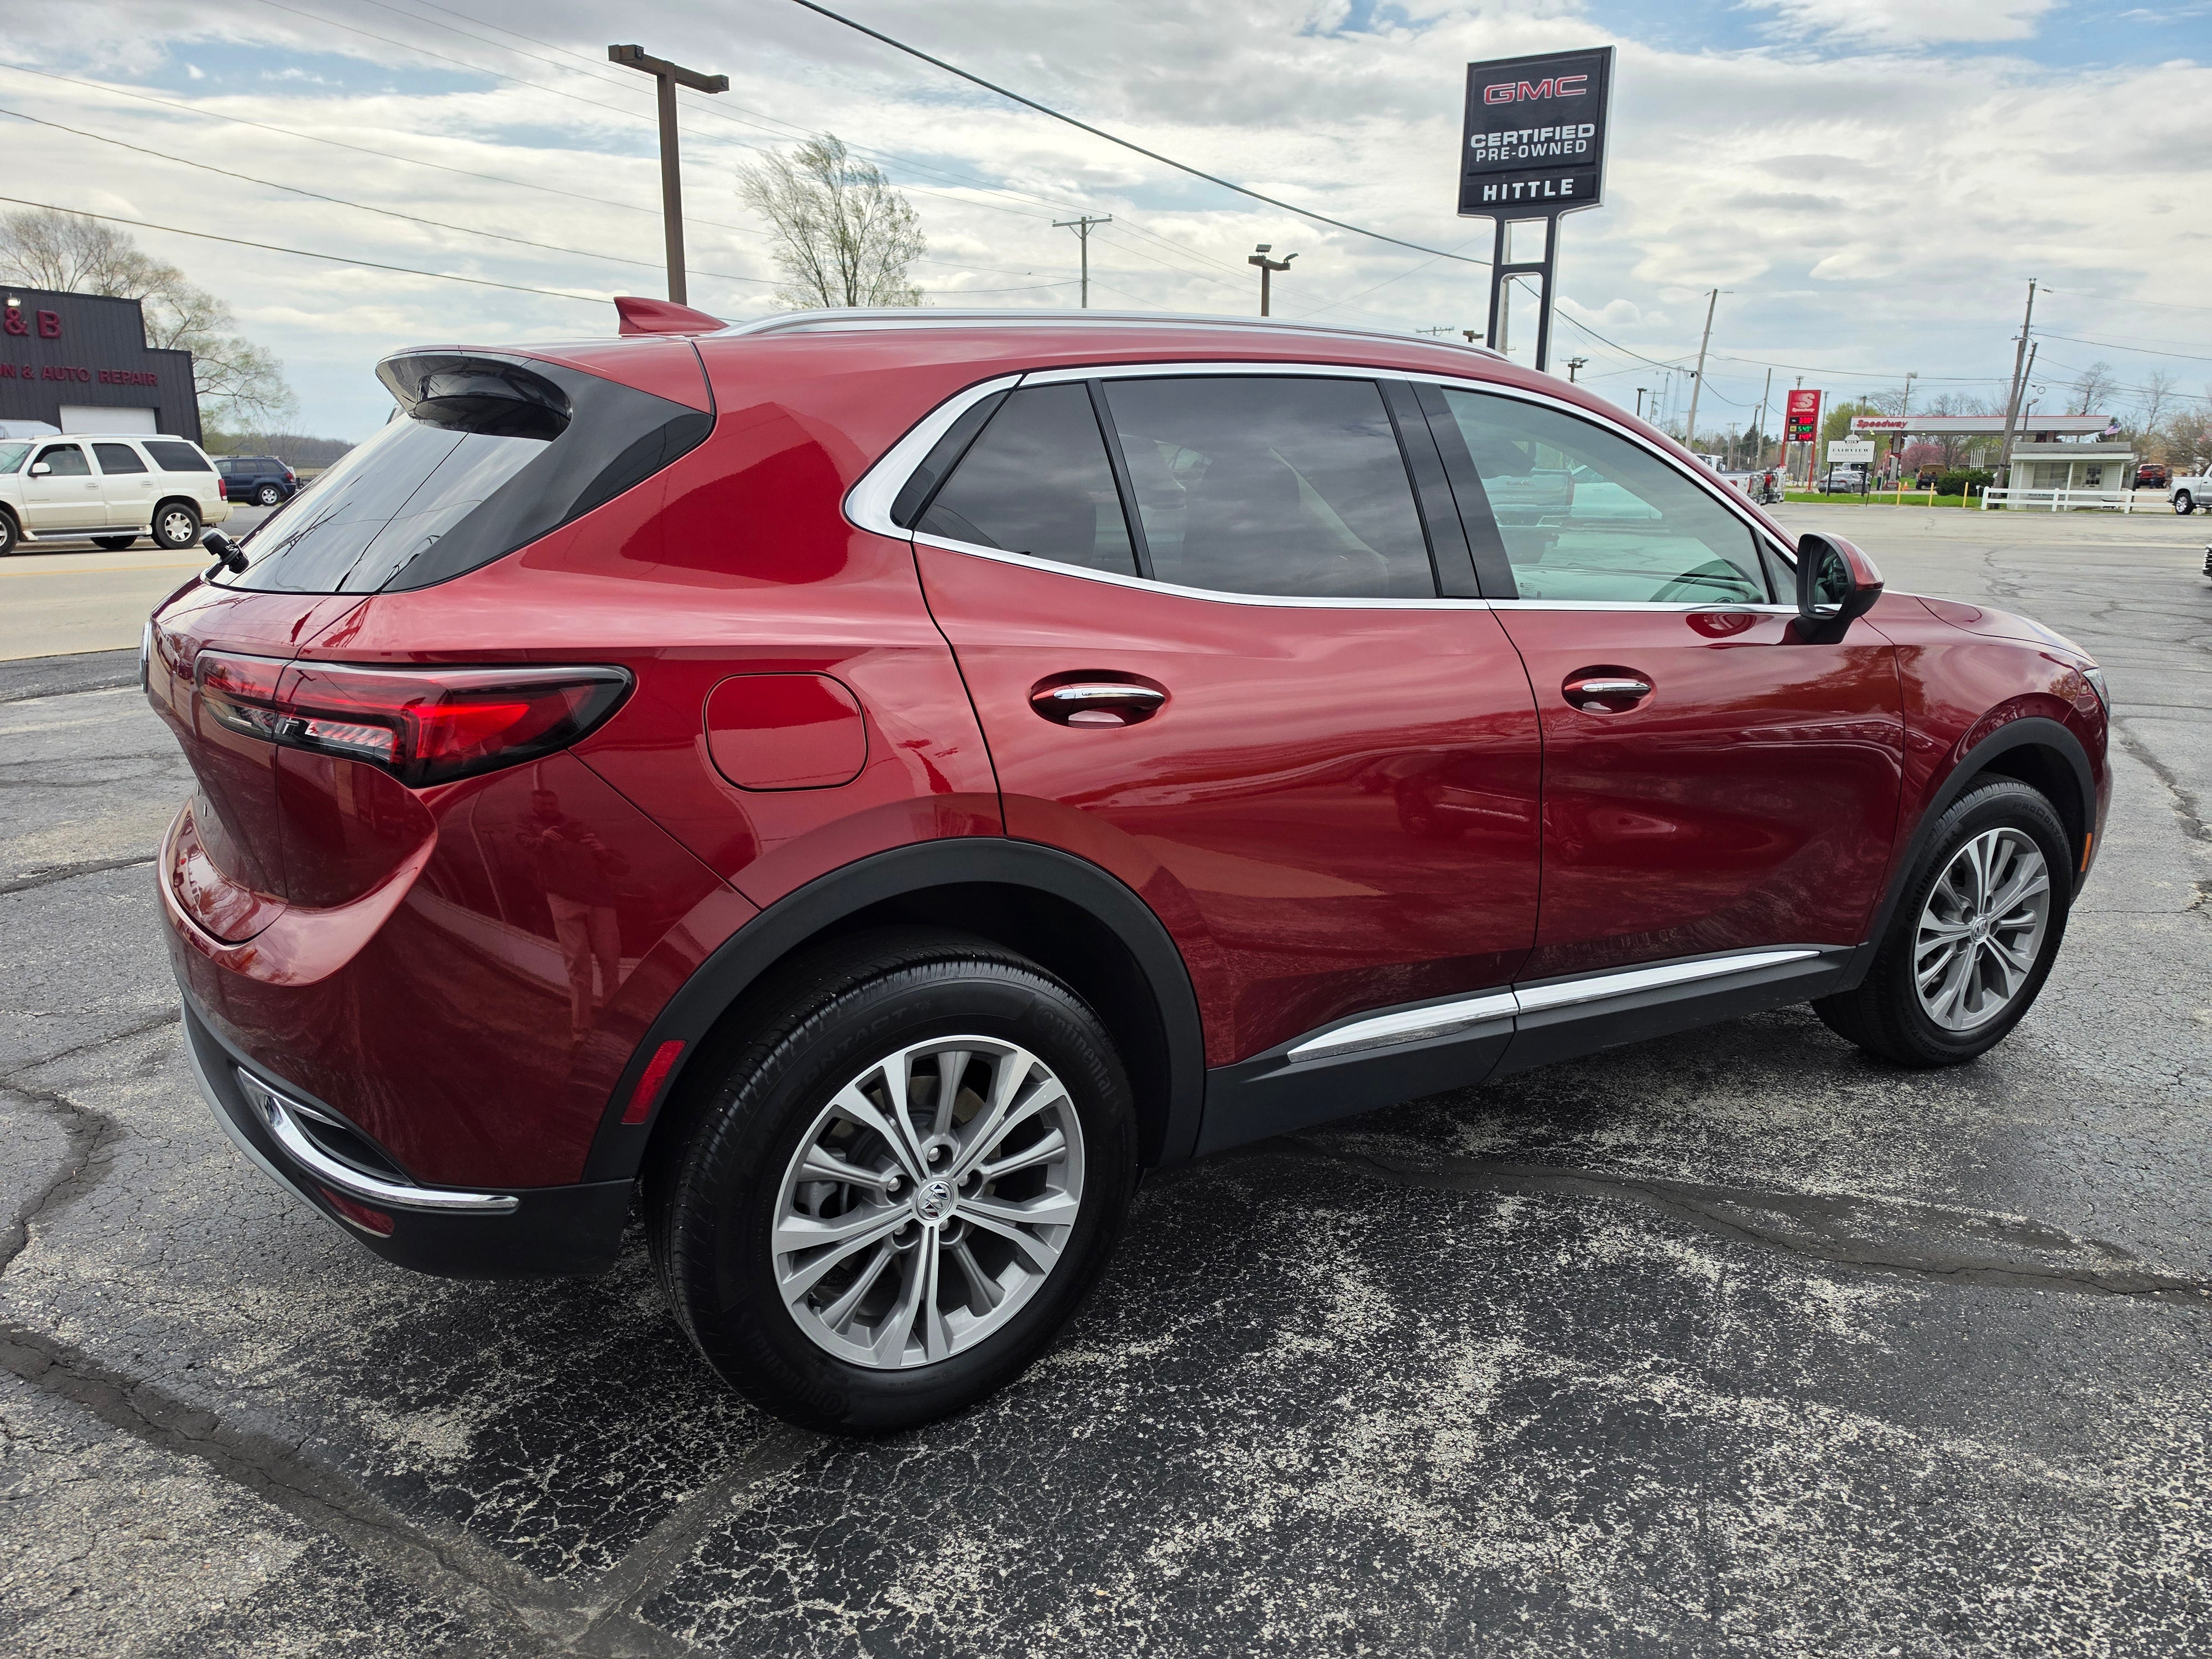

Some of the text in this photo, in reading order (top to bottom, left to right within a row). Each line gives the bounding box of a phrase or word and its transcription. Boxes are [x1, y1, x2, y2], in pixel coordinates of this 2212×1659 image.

[1484, 75, 1588, 105] GMC
[1470, 123, 1595, 148] CERTIFIED
[1476, 139, 1587, 162] PRE-OWNED
[1483, 178, 1574, 201] HITTLE
[3, 306, 62, 339] & B
[0, 363, 158, 386] N & AUTO REPAIR
[1796, 393, 1815, 408] S
[1856, 419, 1908, 429] Speedway
